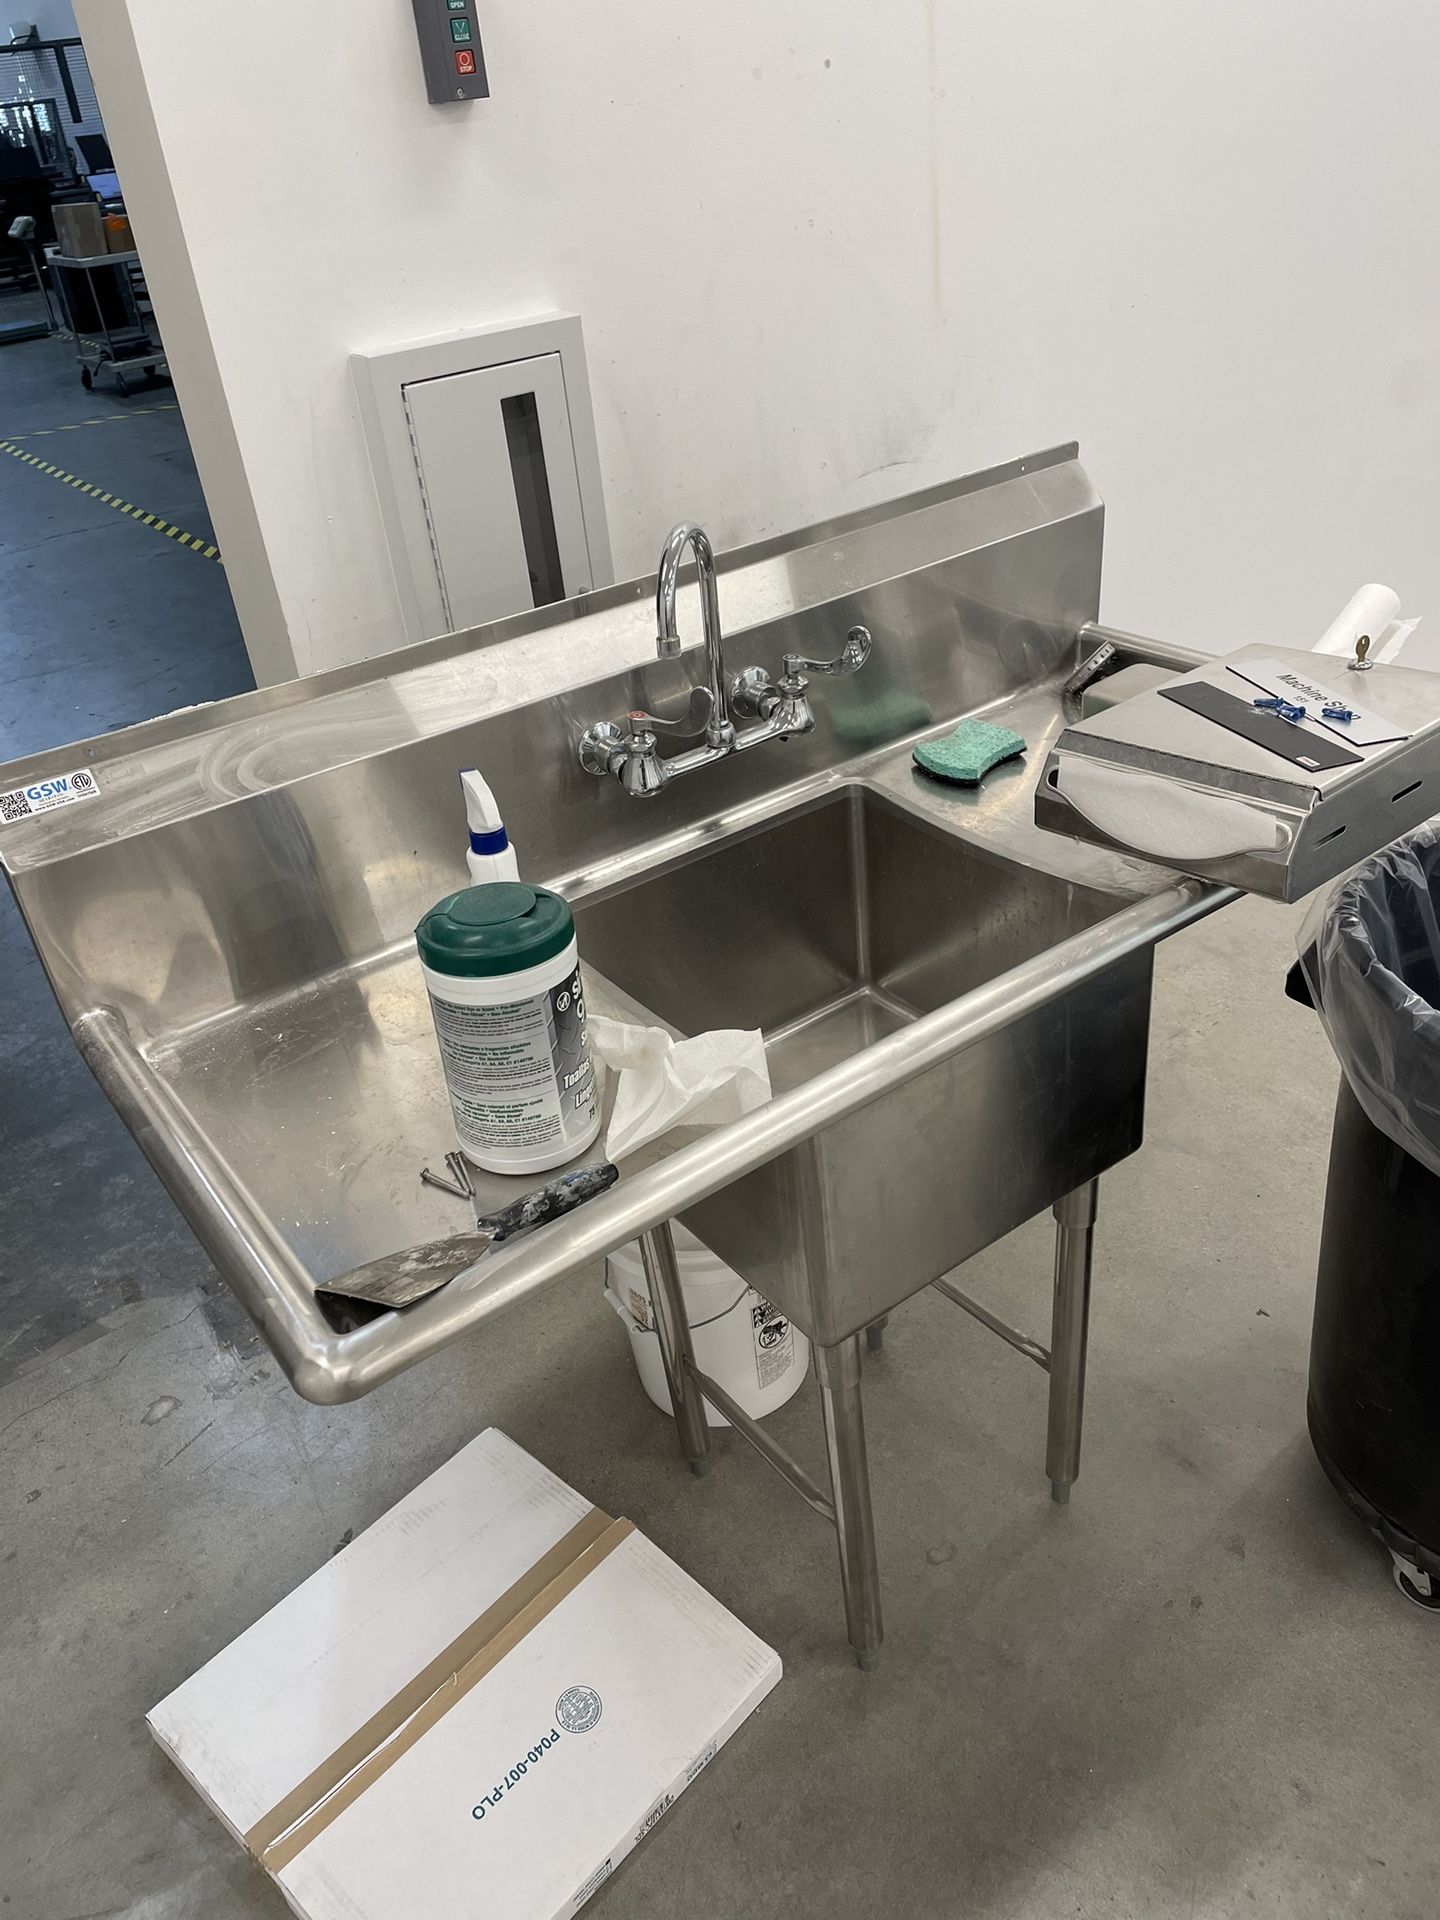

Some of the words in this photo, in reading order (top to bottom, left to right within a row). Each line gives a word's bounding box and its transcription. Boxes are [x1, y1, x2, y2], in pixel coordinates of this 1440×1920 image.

[460, 65, 473, 73] STOP
[1276, 674, 1328, 702] Machine
[1324, 700, 1362, 720] Shp
[26, 778, 68, 800] GSW
[472, 1728, 561, 1820] P040-007-PLO
